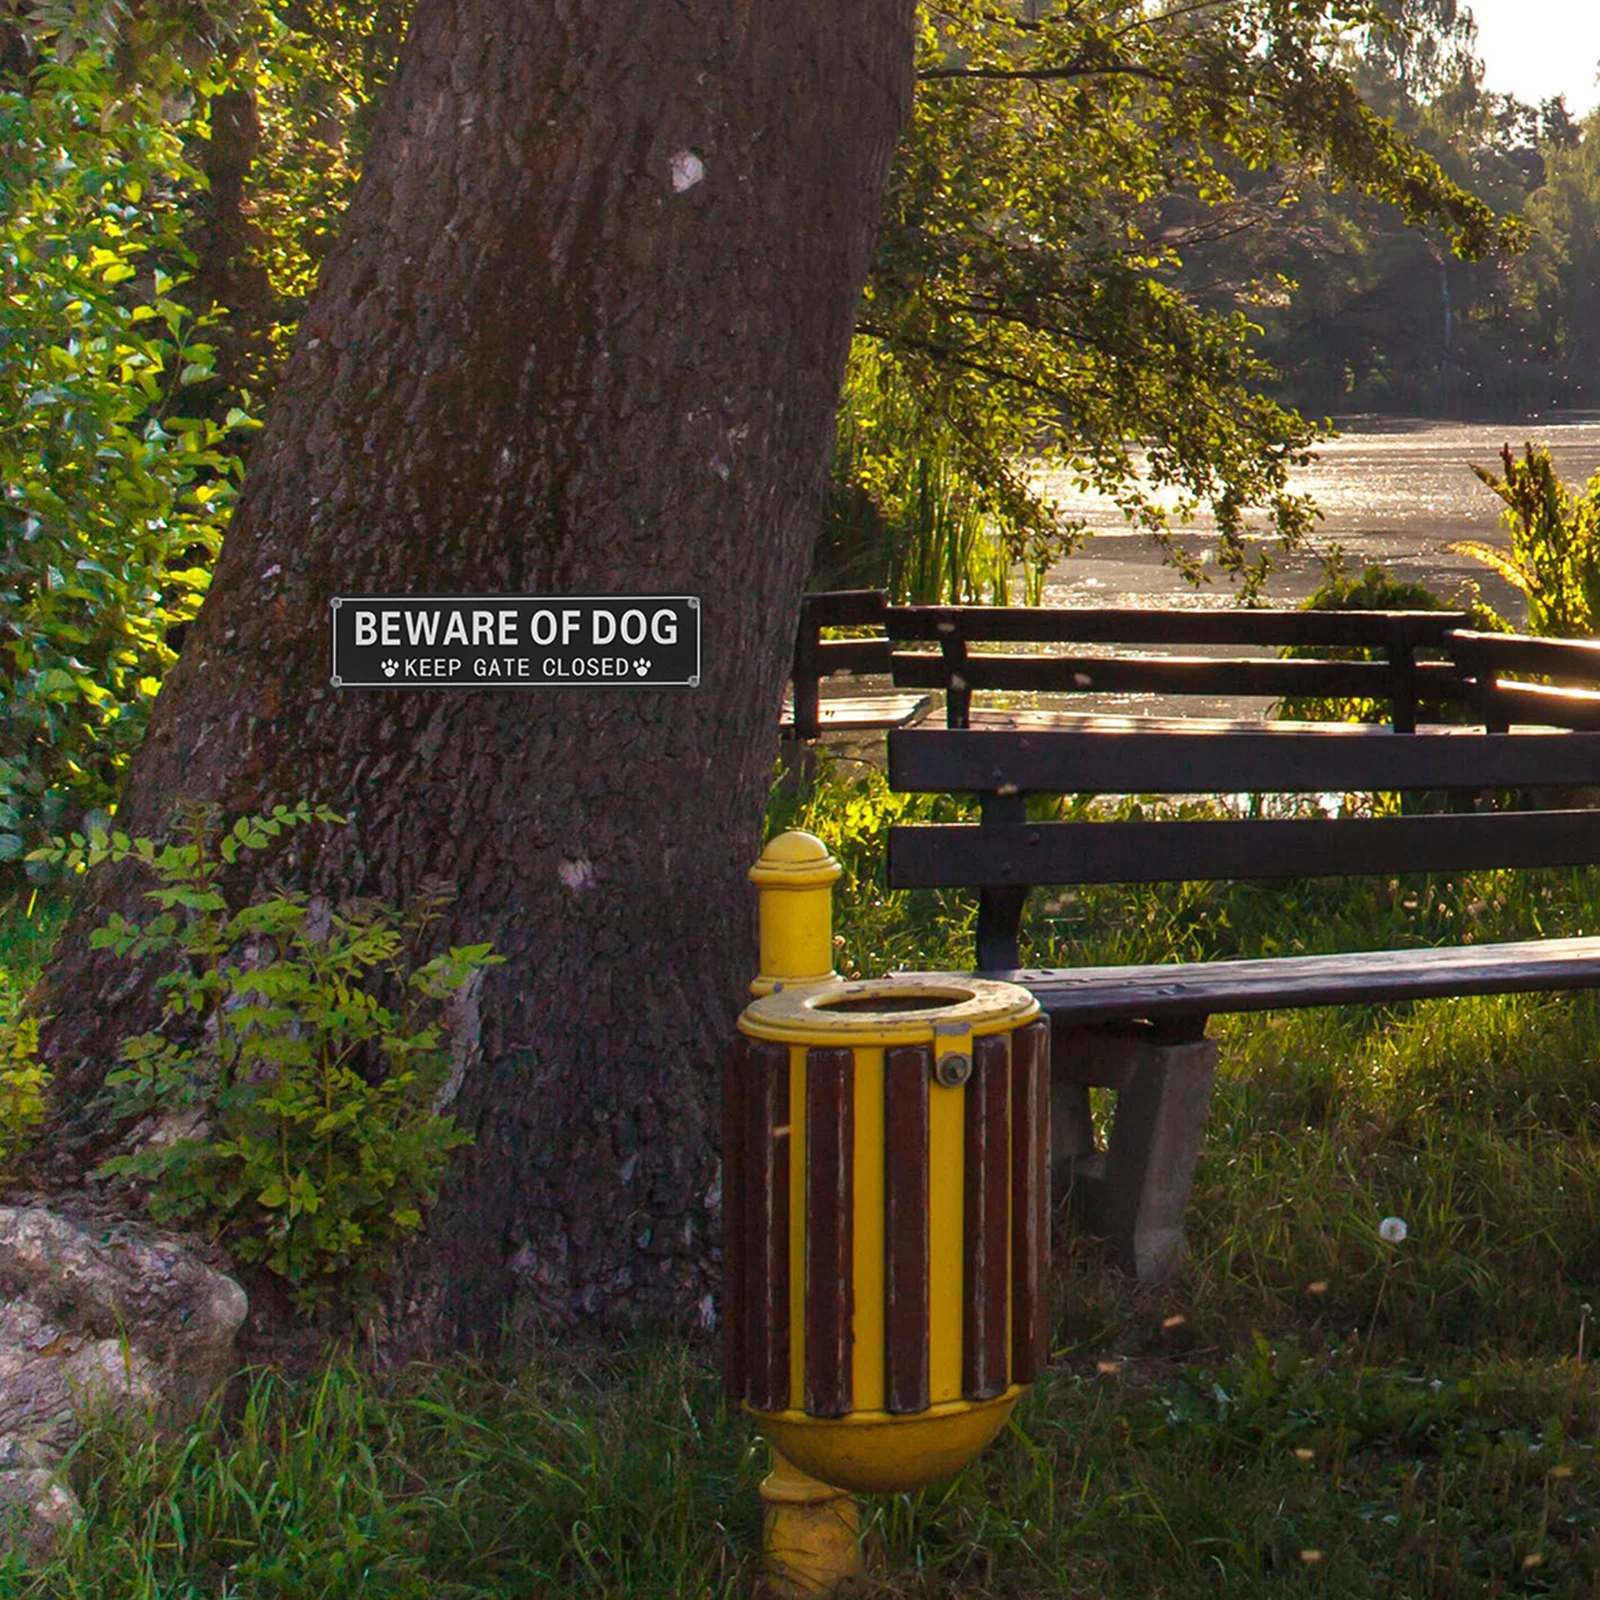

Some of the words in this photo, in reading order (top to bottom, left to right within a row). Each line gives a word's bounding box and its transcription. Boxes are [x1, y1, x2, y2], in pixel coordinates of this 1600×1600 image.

[355, 609, 519, 647] BEWARE
[530, 609, 581, 646] OF
[592, 608, 678, 646] DOG
[404, 658, 462, 678] KEEP
[473, 658, 530, 677] GATE
[542, 657, 629, 677] CLOSED
